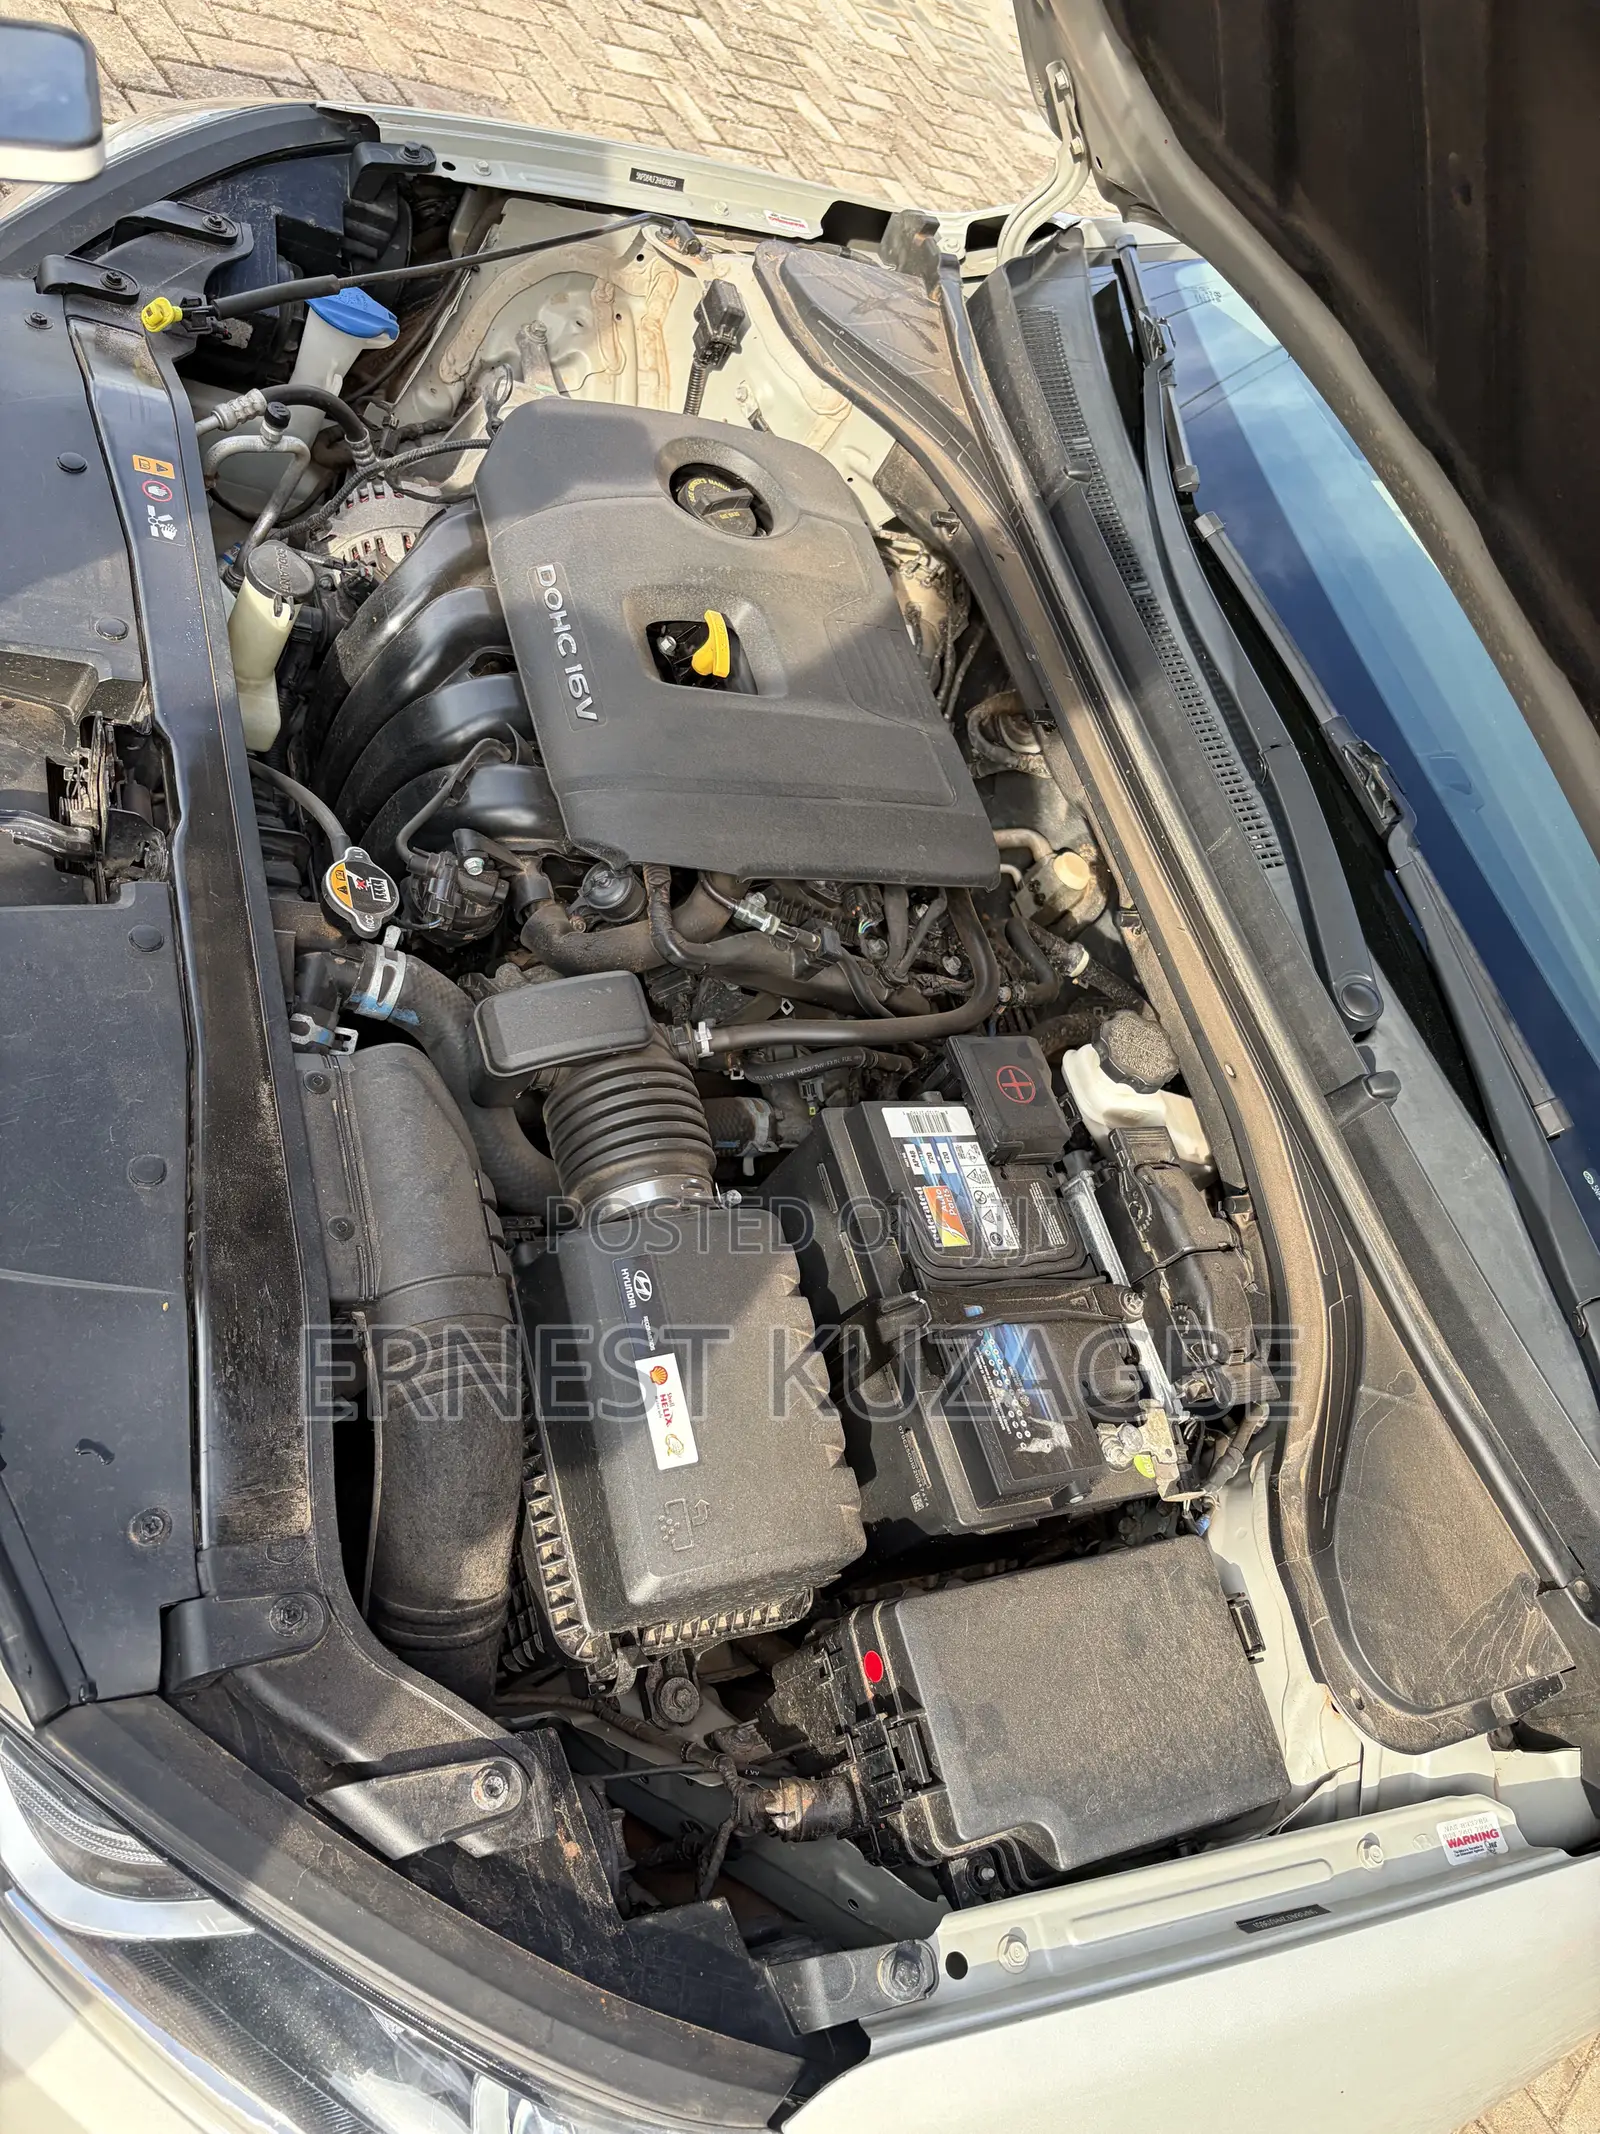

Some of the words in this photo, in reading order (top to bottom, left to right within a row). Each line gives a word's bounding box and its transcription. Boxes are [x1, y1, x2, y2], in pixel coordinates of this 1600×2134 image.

[274, 546, 291, 593] COOLANT
[536, 564, 577, 657] DOHC
[564, 664, 599, 721] 16V
[926, 1152, 935, 1167] 720
[942, 1151, 951, 1164] 120
[936, 1189, 949, 1212] Auto
[621, 1268, 637, 1309] HYUNDAI
[660, 1393, 673, 1427] HELIX
[1446, 1828, 1500, 1848] WARNING
